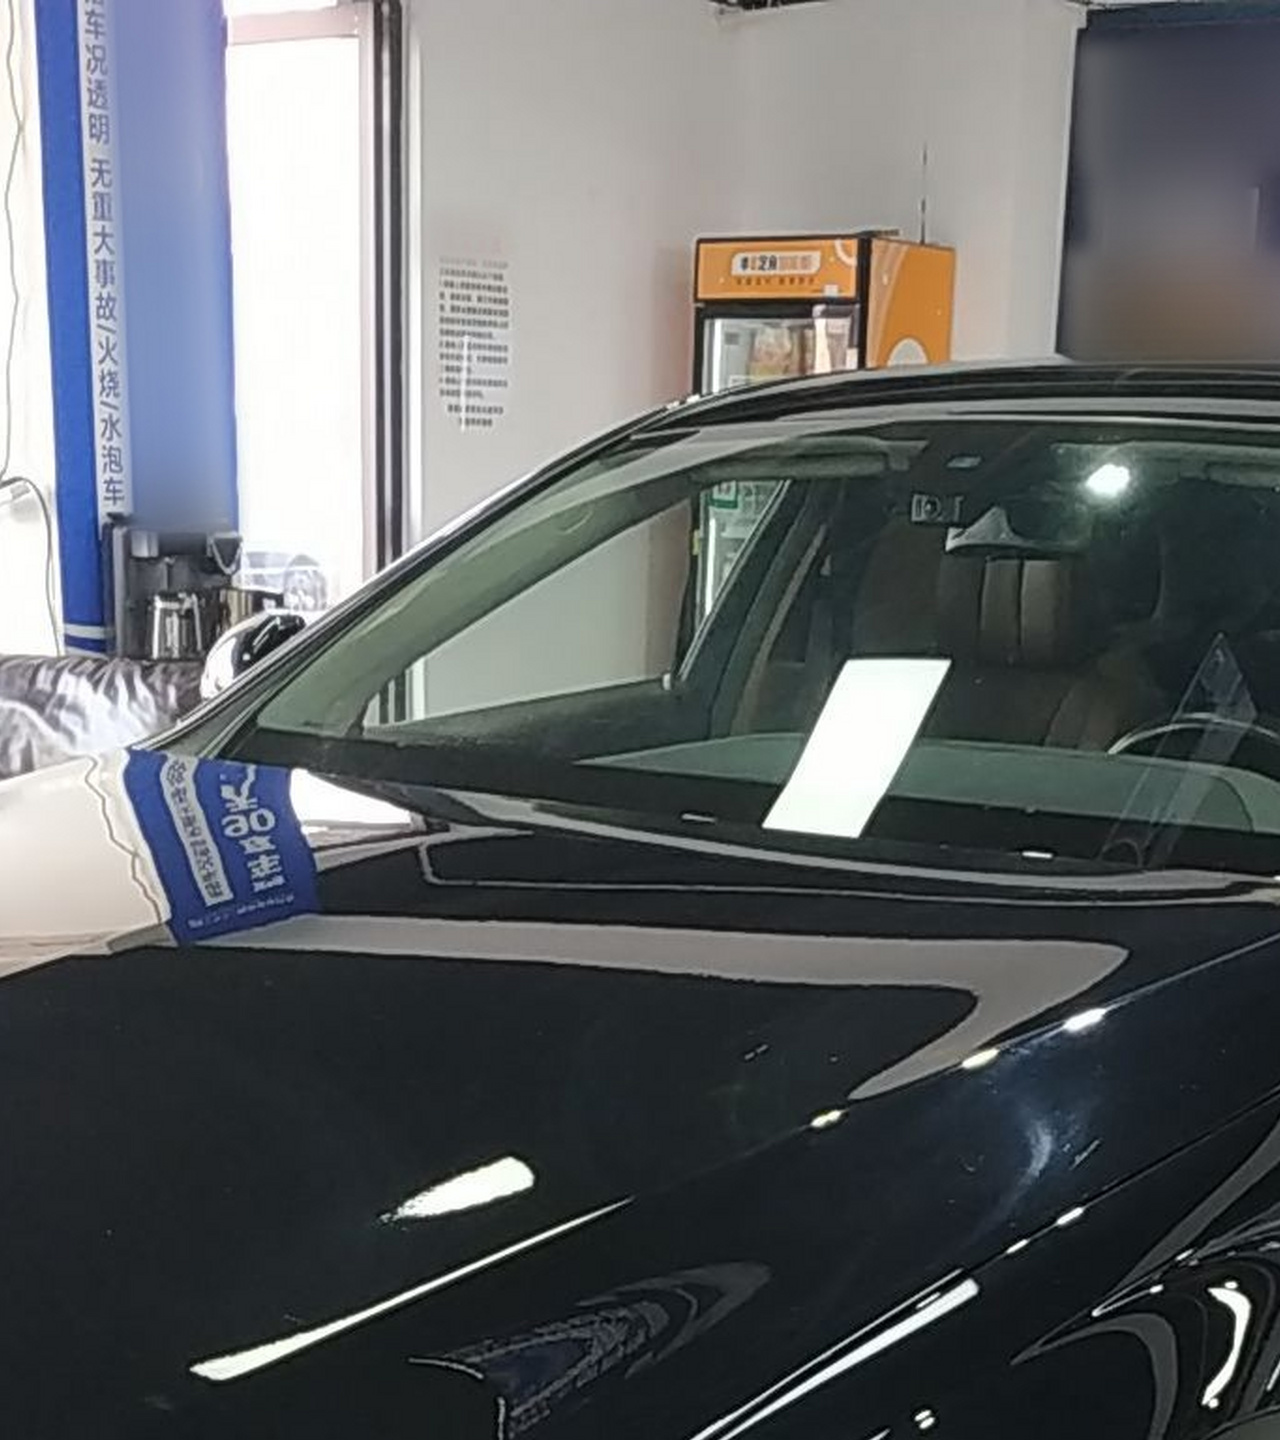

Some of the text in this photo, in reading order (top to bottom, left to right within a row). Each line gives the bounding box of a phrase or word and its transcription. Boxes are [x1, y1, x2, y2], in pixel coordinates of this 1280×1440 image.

[84, 0, 125, 507] 车况透明 无重大事故/火烧/水泡车
